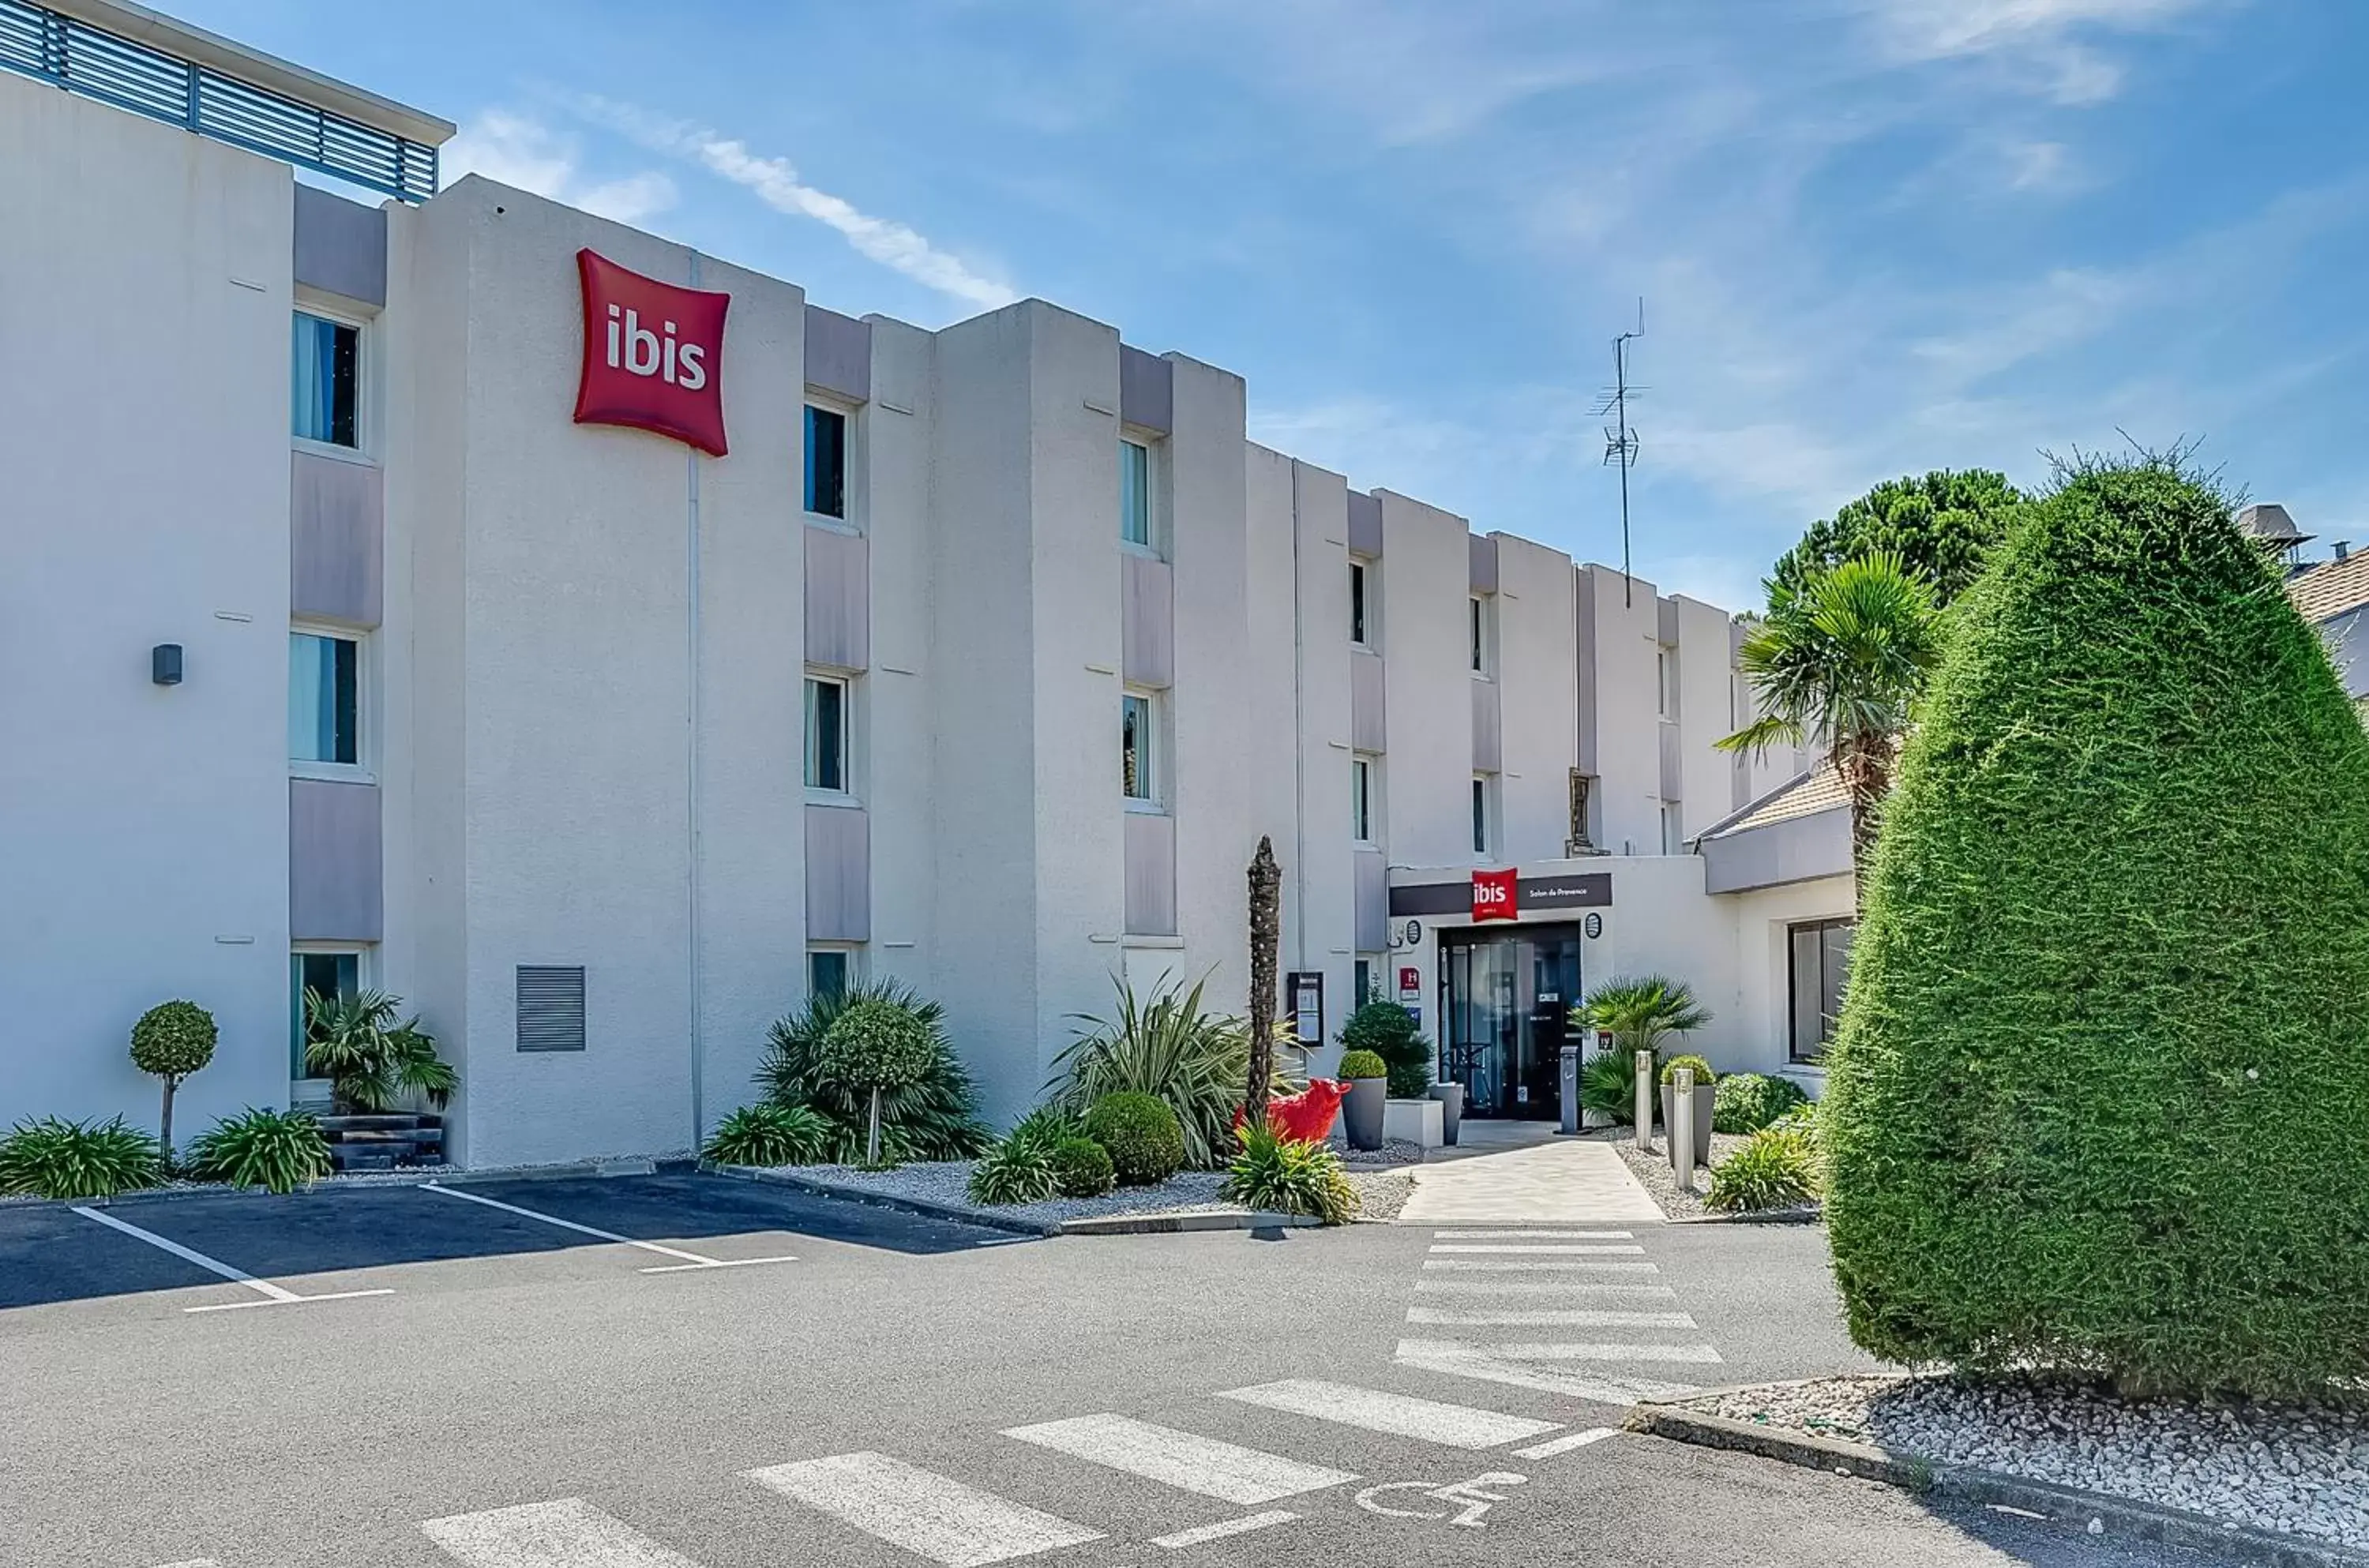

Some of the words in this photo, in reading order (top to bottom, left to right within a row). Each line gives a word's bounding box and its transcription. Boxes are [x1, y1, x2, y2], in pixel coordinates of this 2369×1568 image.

[607, 304, 705, 390] ibis
[1474, 882, 1506, 904] ibis
[1408, 972, 1417, 983] H
